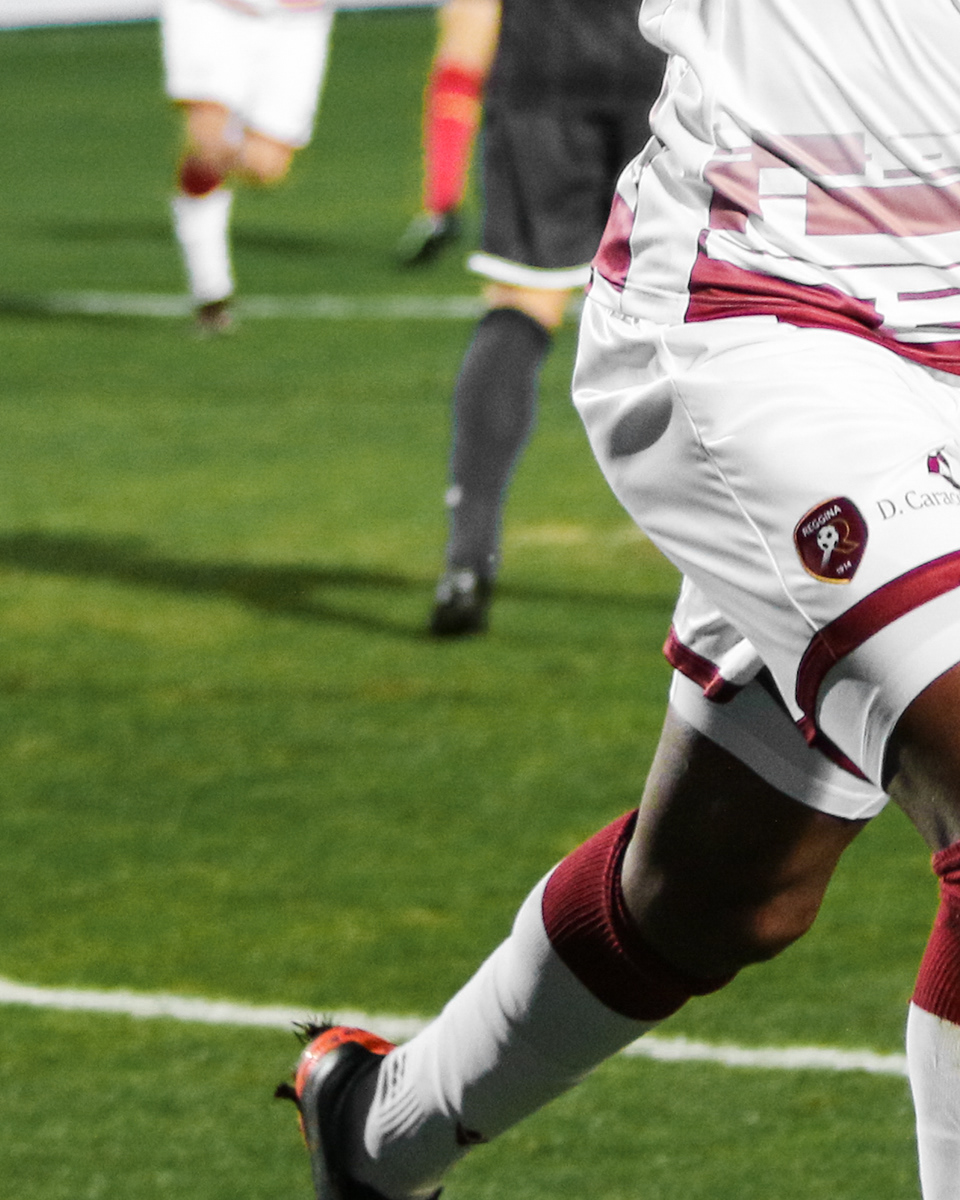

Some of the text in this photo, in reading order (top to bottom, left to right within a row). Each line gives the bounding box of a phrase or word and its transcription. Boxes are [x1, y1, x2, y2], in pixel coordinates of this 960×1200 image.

[876, 499, 904, 520] D.
[801, 504, 842, 537] REGGINA
[836, 560, 853, 575] 1914
